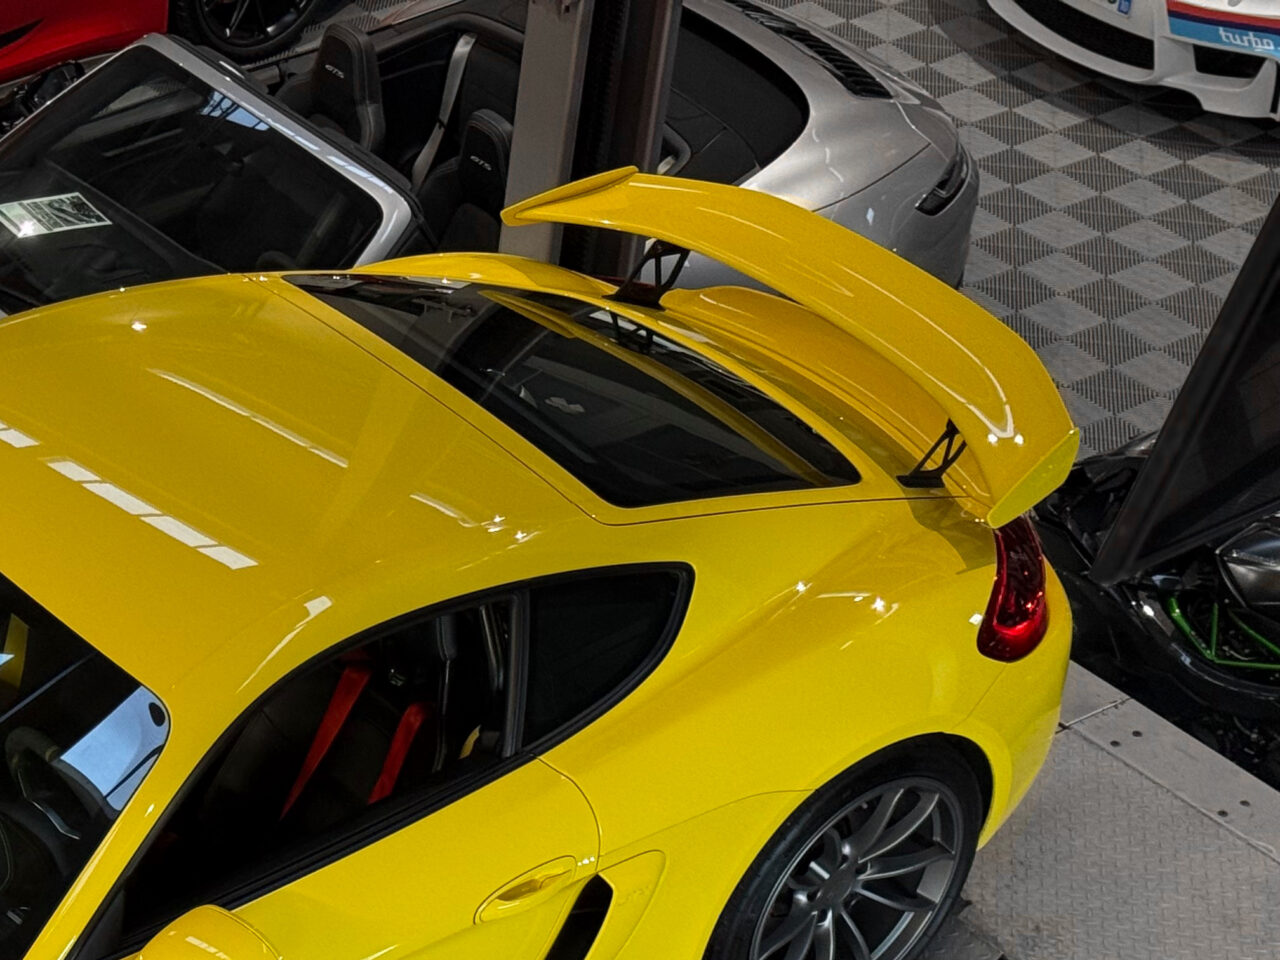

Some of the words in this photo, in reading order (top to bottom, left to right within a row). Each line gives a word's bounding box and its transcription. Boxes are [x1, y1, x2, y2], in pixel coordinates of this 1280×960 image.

[1218, 26, 1275, 51] turbo
[324, 64, 345, 79] GTS
[469, 155, 493, 172] GTS
